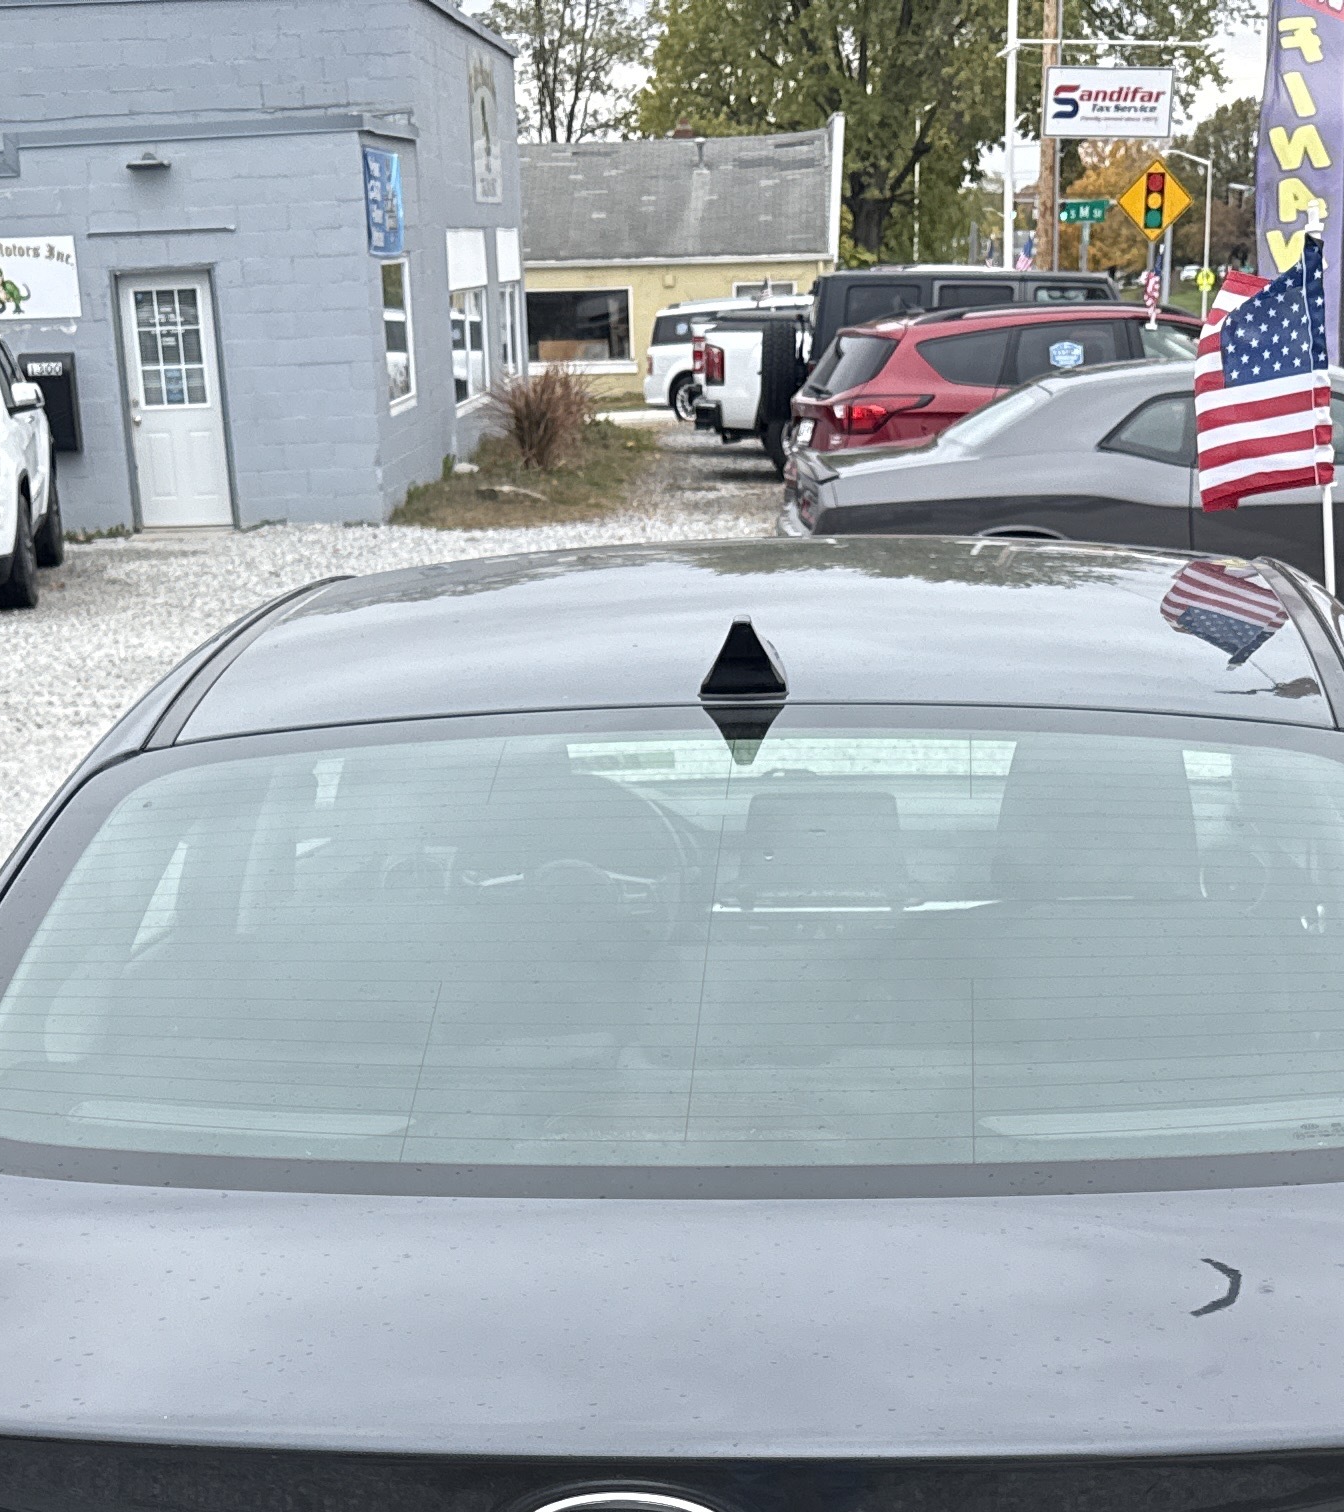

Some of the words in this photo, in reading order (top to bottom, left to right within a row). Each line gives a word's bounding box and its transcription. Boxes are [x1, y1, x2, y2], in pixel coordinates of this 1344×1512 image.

[1052, 84, 1167, 119] Sandifar
[1091, 103, 1112, 113] Tax
[1113, 103, 1157, 113] Service
[1079, 205, 1090, 219] M
[45, 243, 75, 267] Inc.
